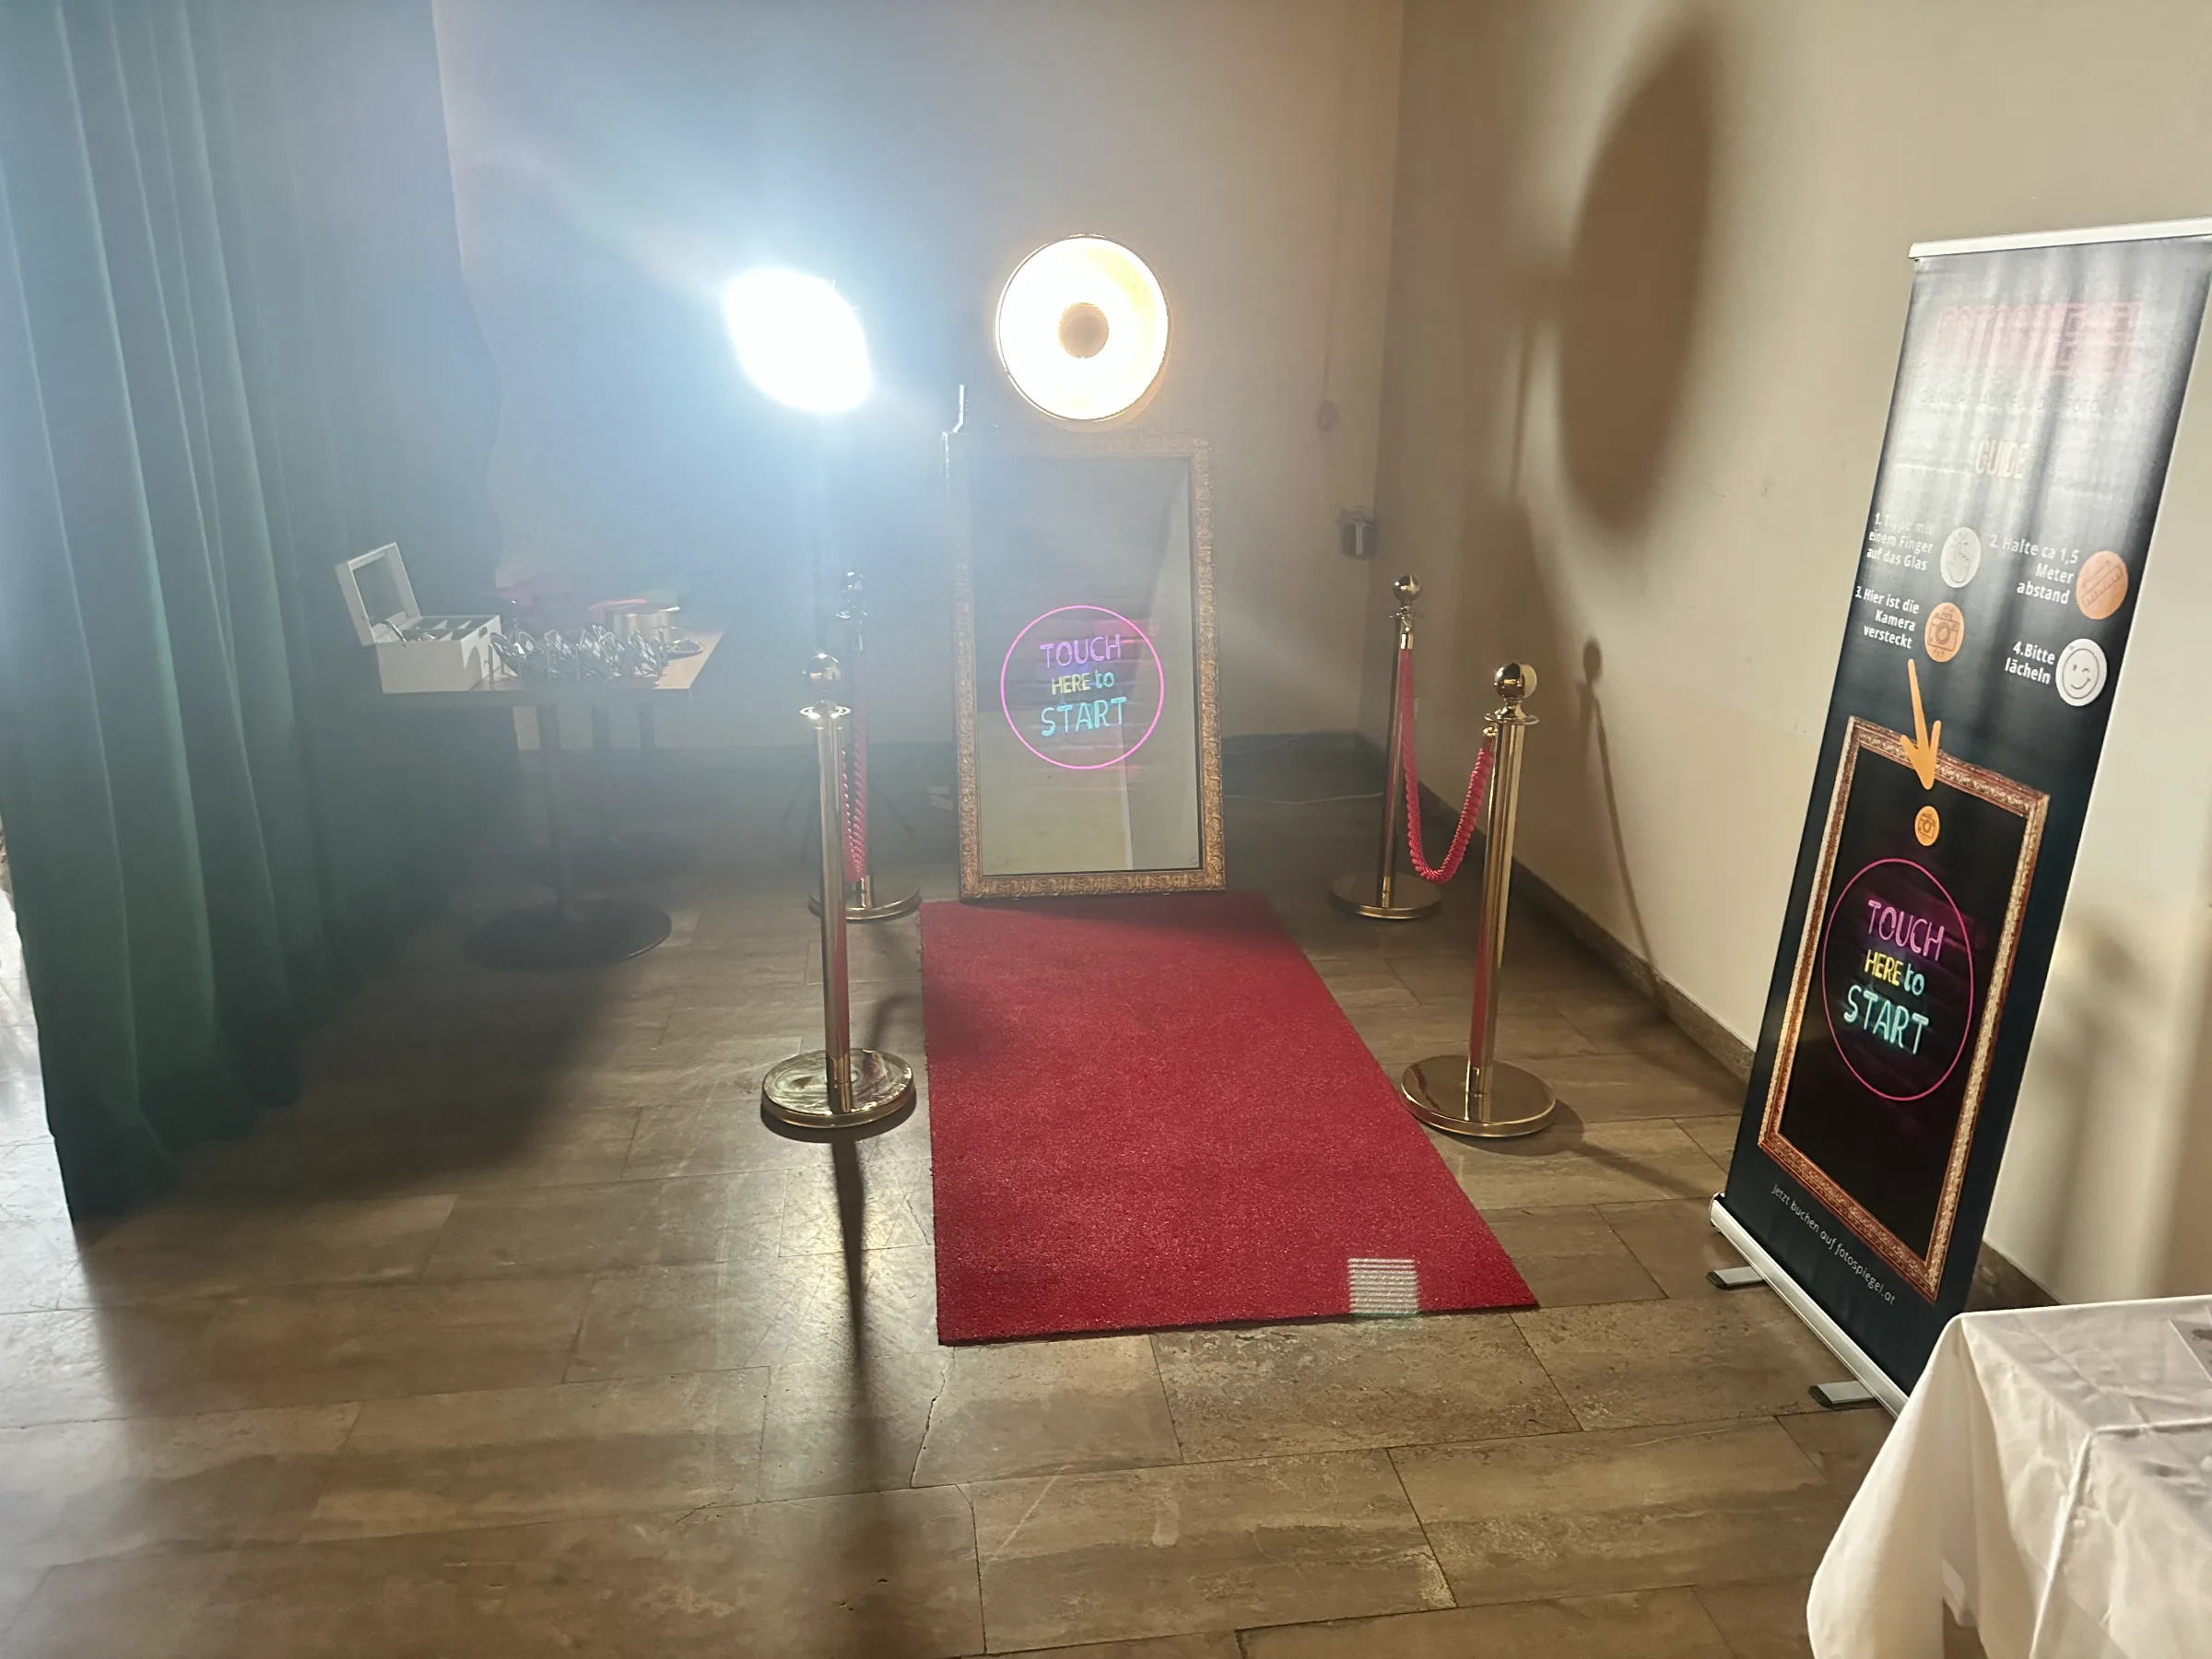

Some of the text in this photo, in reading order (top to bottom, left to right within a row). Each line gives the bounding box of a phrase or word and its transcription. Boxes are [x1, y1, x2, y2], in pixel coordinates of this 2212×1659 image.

[1875, 512, 1881, 525] 1.
[1868, 529, 1935, 555] einem Finger
[2002, 536, 2039, 556] Halte
[2041, 547, 2056, 559] ca
[2060, 547, 2079, 565] 1,5
[1866, 547, 1928, 571] auf das Glas
[2035, 562, 2075, 584] Meter
[1885, 594, 1900, 609] ist
[1902, 598, 1920, 614] die
[2017, 580, 2071, 605] abstand
[1875, 609, 1917, 631] Kamera
[1864, 625, 1913, 649] versteckt
[1040, 633, 1122, 668] TOUCH
[1052, 669, 1115, 695] HERE to
[2005, 656, 2052, 685] lächeln
[1041, 696, 1128, 737] START
[1867, 899, 1945, 961] TOUCH
[1864, 949, 1925, 996] HERE to
[1843, 984, 1930, 1055] START
[1790, 1199, 1819, 1233] buchen
[1819, 1230, 1838, 1250] auf
[1834, 1243, 1896, 1306] fotospiegel.at
